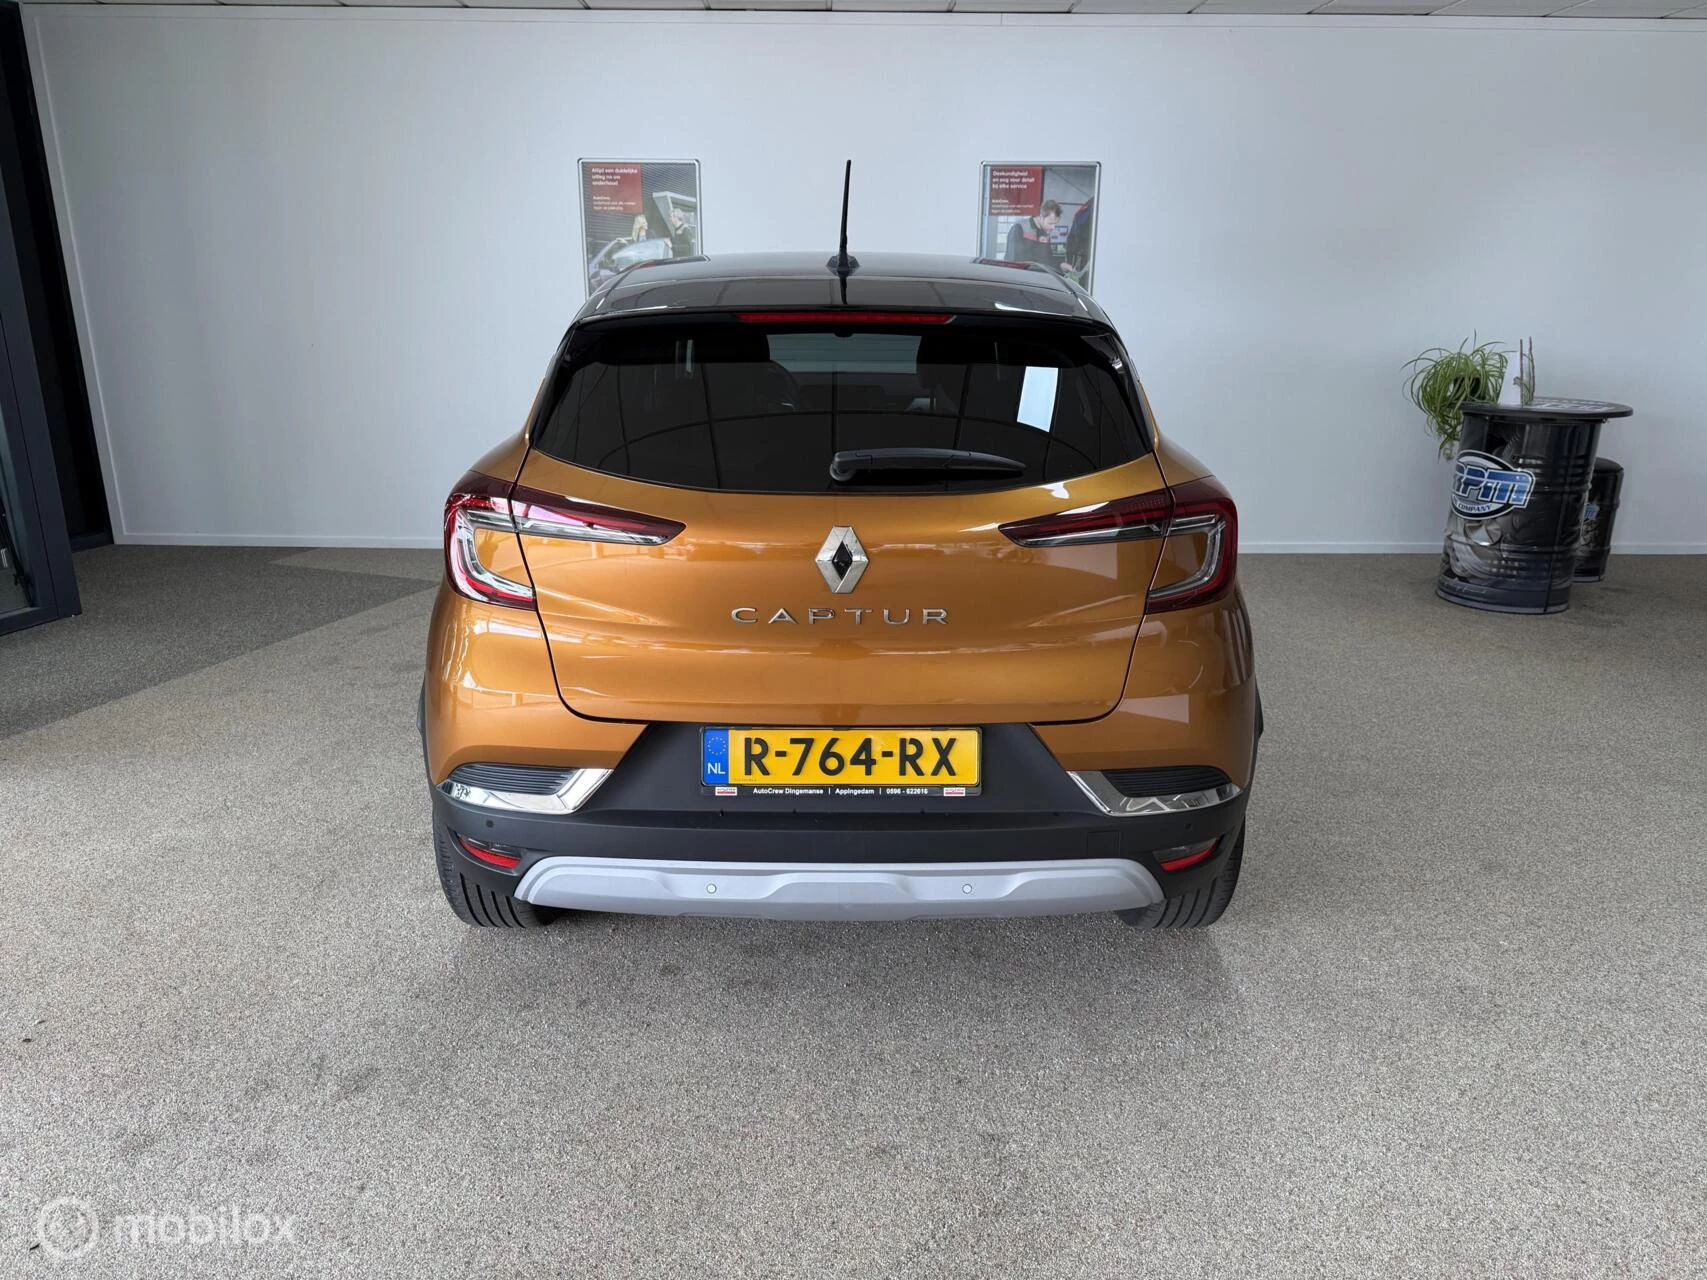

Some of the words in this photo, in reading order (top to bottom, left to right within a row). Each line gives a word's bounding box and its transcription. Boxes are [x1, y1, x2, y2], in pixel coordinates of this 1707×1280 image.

[1458, 502, 1493, 512] COMPANY
[731, 607, 950, 625] CAPTUR
[744, 737, 957, 776] R-764-RX
[707, 762, 726, 775] NL
[753, 787, 785, 795] AutoCrew
[834, 787, 875, 796] Appingedam
